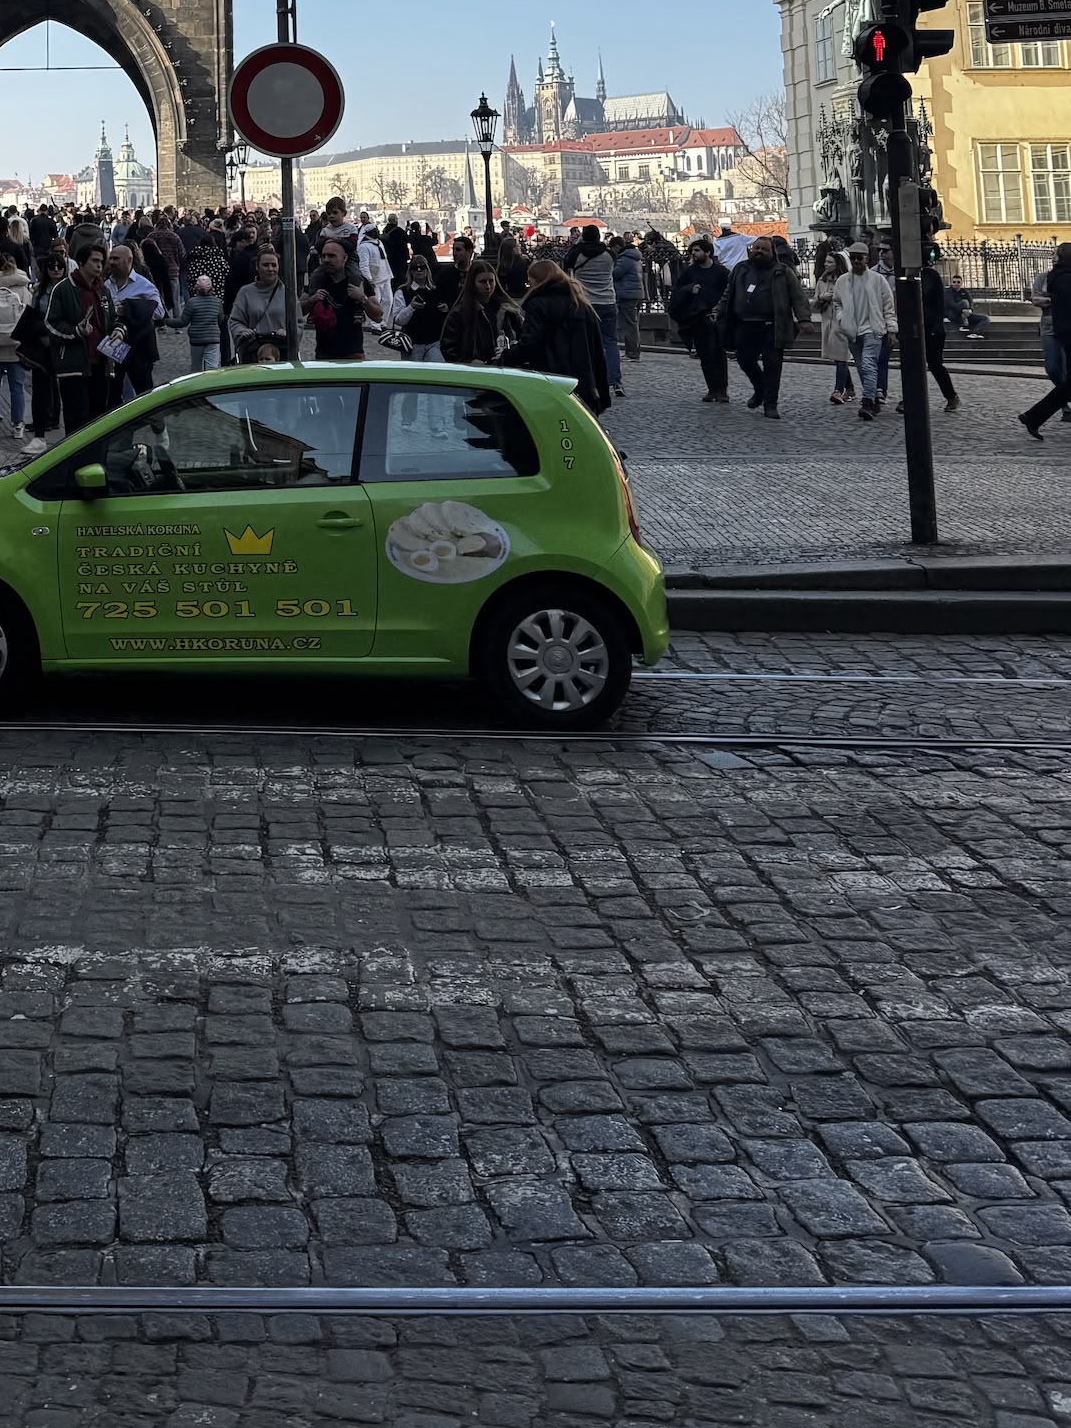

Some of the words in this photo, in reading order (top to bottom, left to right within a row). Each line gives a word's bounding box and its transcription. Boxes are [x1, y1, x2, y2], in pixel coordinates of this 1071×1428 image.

[1007, 0, 1039, 12] Muzeum
[558, 419, 576, 470] 107
[76, 523, 145, 537] HAVELSKÁ
[146, 523, 202, 536] KORUNA
[76, 542, 202, 558] TRADIČNÍ
[77, 561, 163, 577] ČESKÁ
[173, 560, 299, 575] KUCHYNĚ
[78, 582, 112, 595] NA
[122, 579, 172, 594] VÁŠ
[182, 578, 249, 594] STŮL
[75, 600, 159, 619] 725
[175, 599, 256, 618] 501
[275, 599, 359, 618] 501
[109, 636, 322, 651] WWW.HKORUNA.CZ
